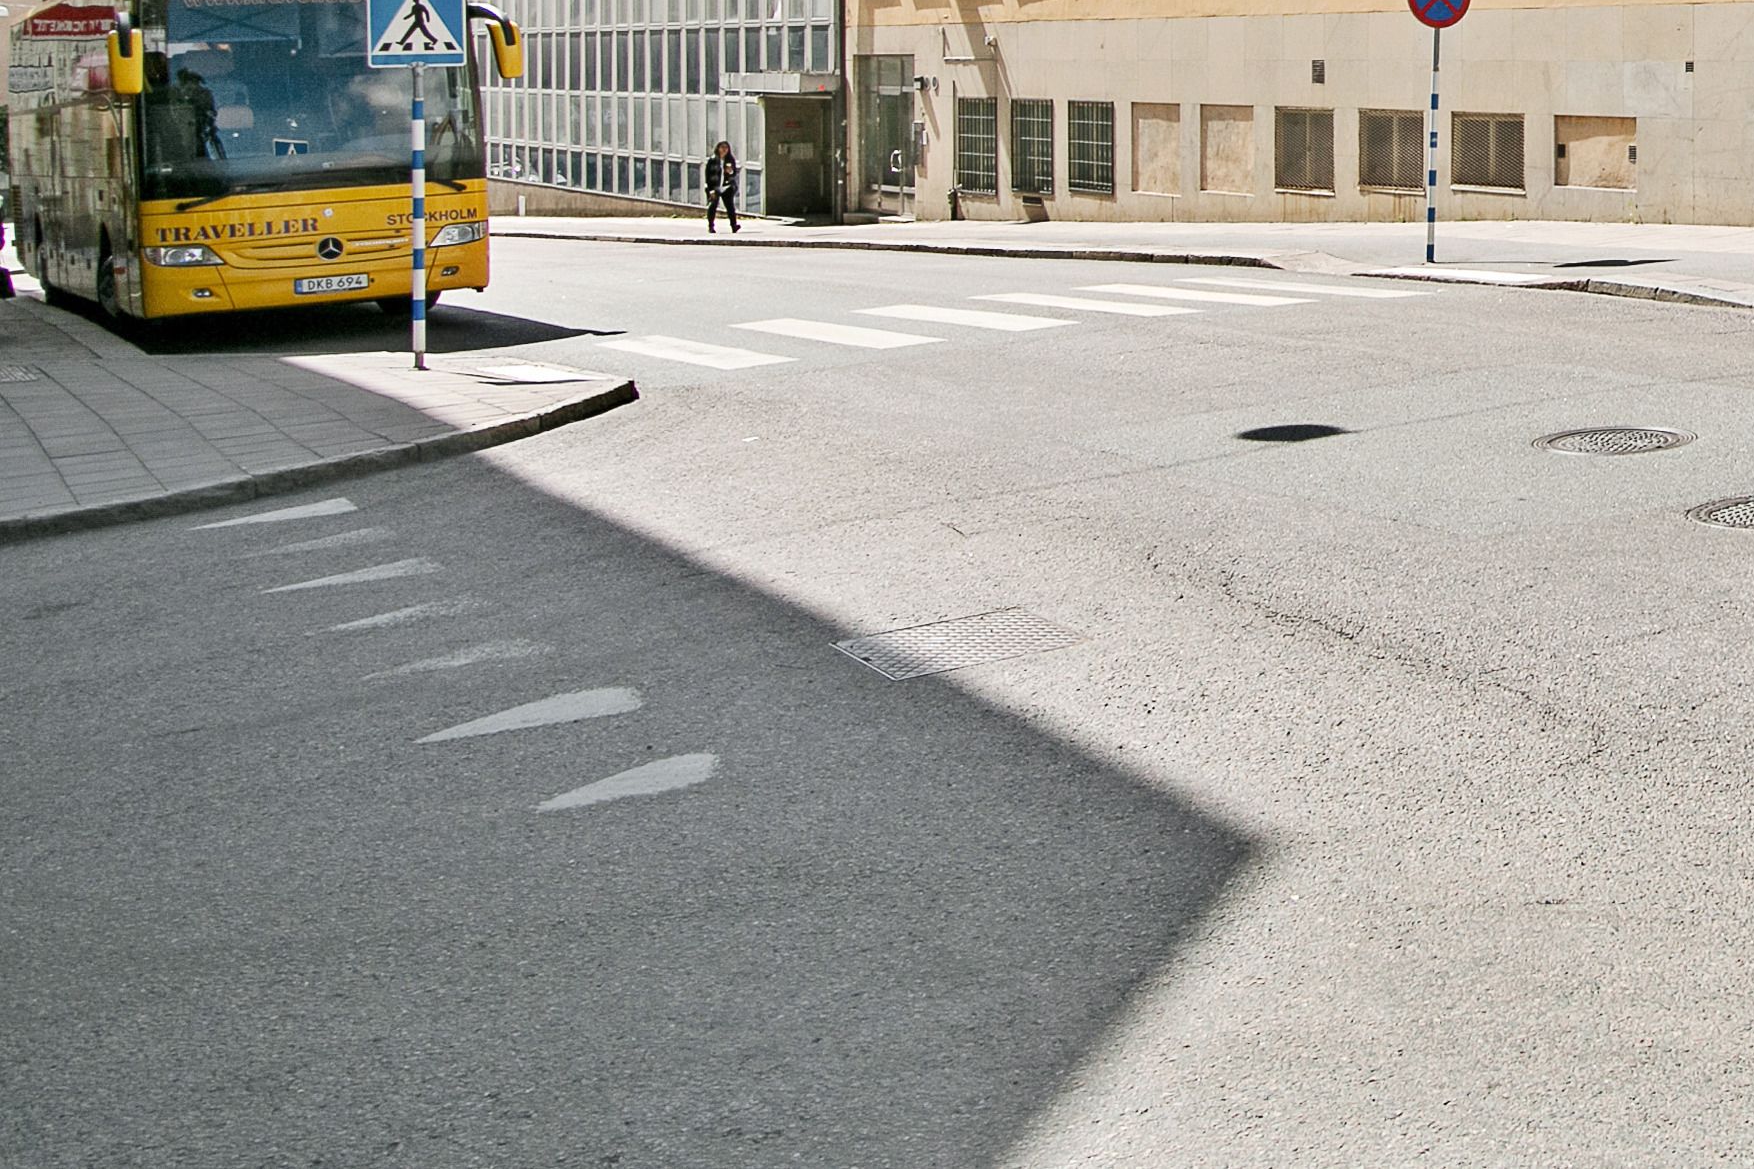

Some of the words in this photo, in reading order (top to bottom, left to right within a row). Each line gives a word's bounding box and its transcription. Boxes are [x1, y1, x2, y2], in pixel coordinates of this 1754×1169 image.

[156, 217, 319, 243] TRAVELLER
[307, 278, 333, 291] DKB
[336, 275, 362, 288] 694
